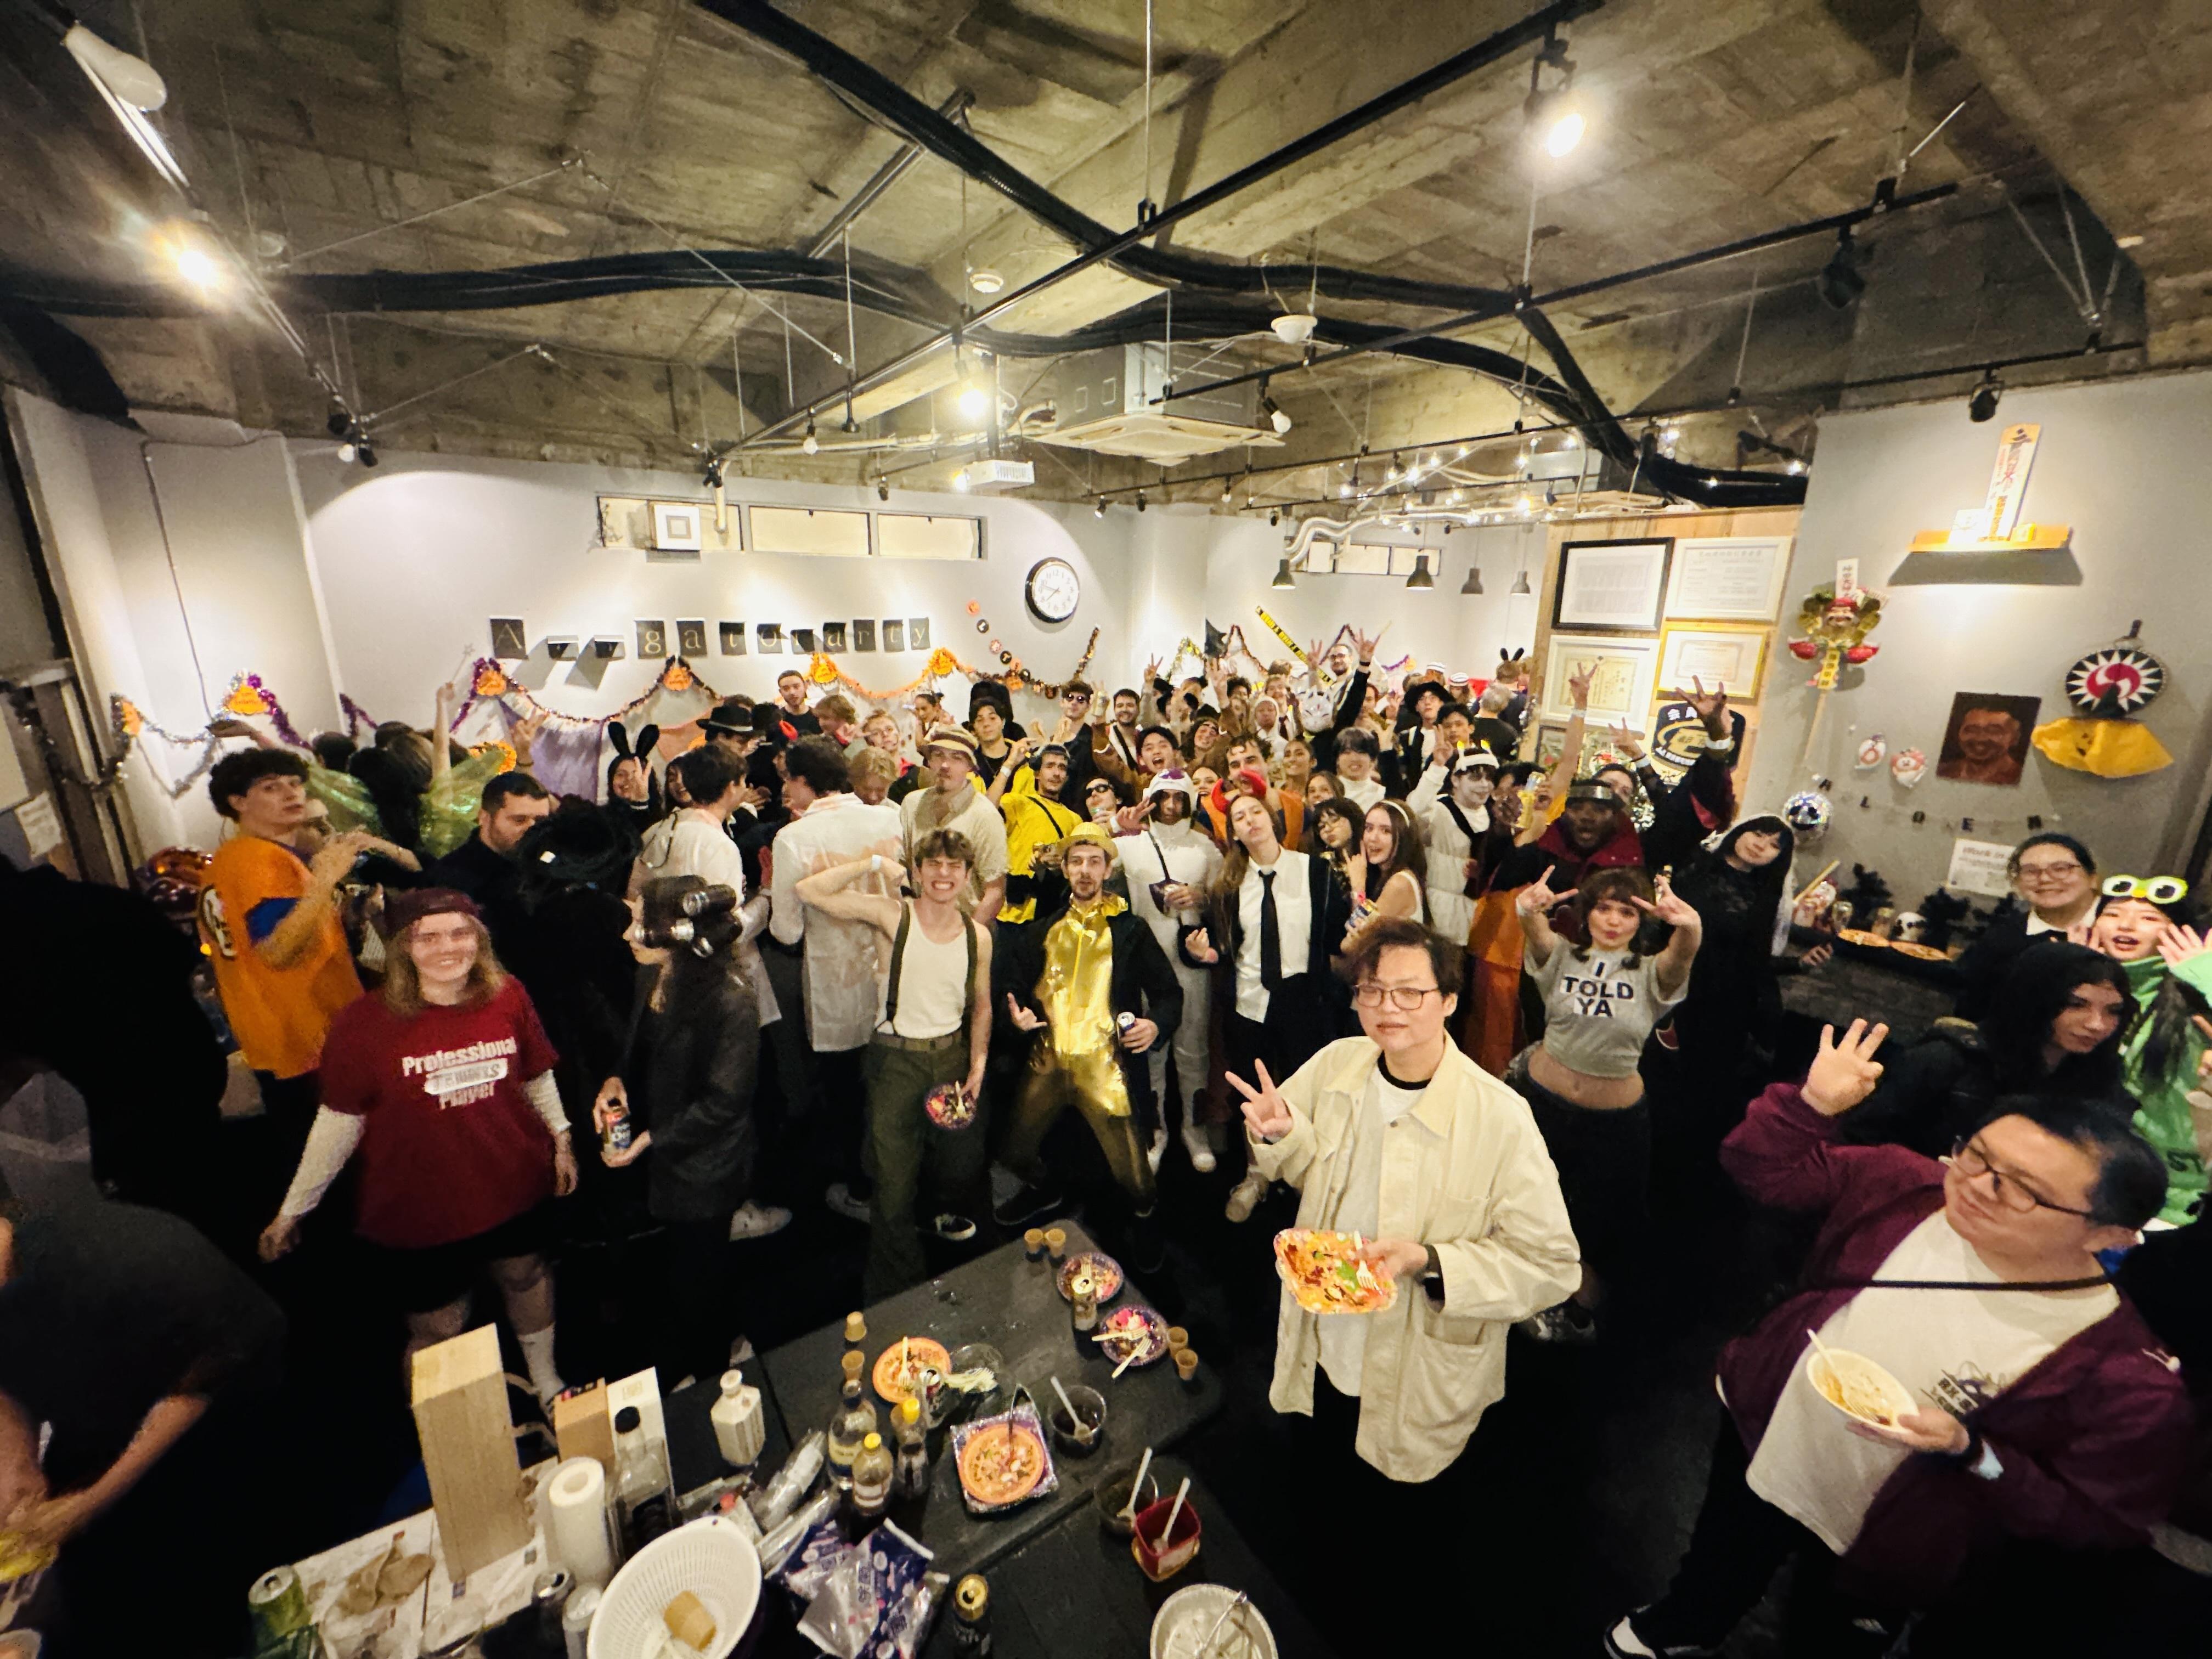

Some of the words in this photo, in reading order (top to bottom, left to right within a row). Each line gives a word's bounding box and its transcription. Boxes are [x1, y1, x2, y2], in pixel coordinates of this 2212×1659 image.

[1595, 962, 1605, 977] I
[1564, 976, 1634, 1000] TOLD
[1577, 997, 1613, 1017] YA
[402, 1036, 517, 1077] Professional
